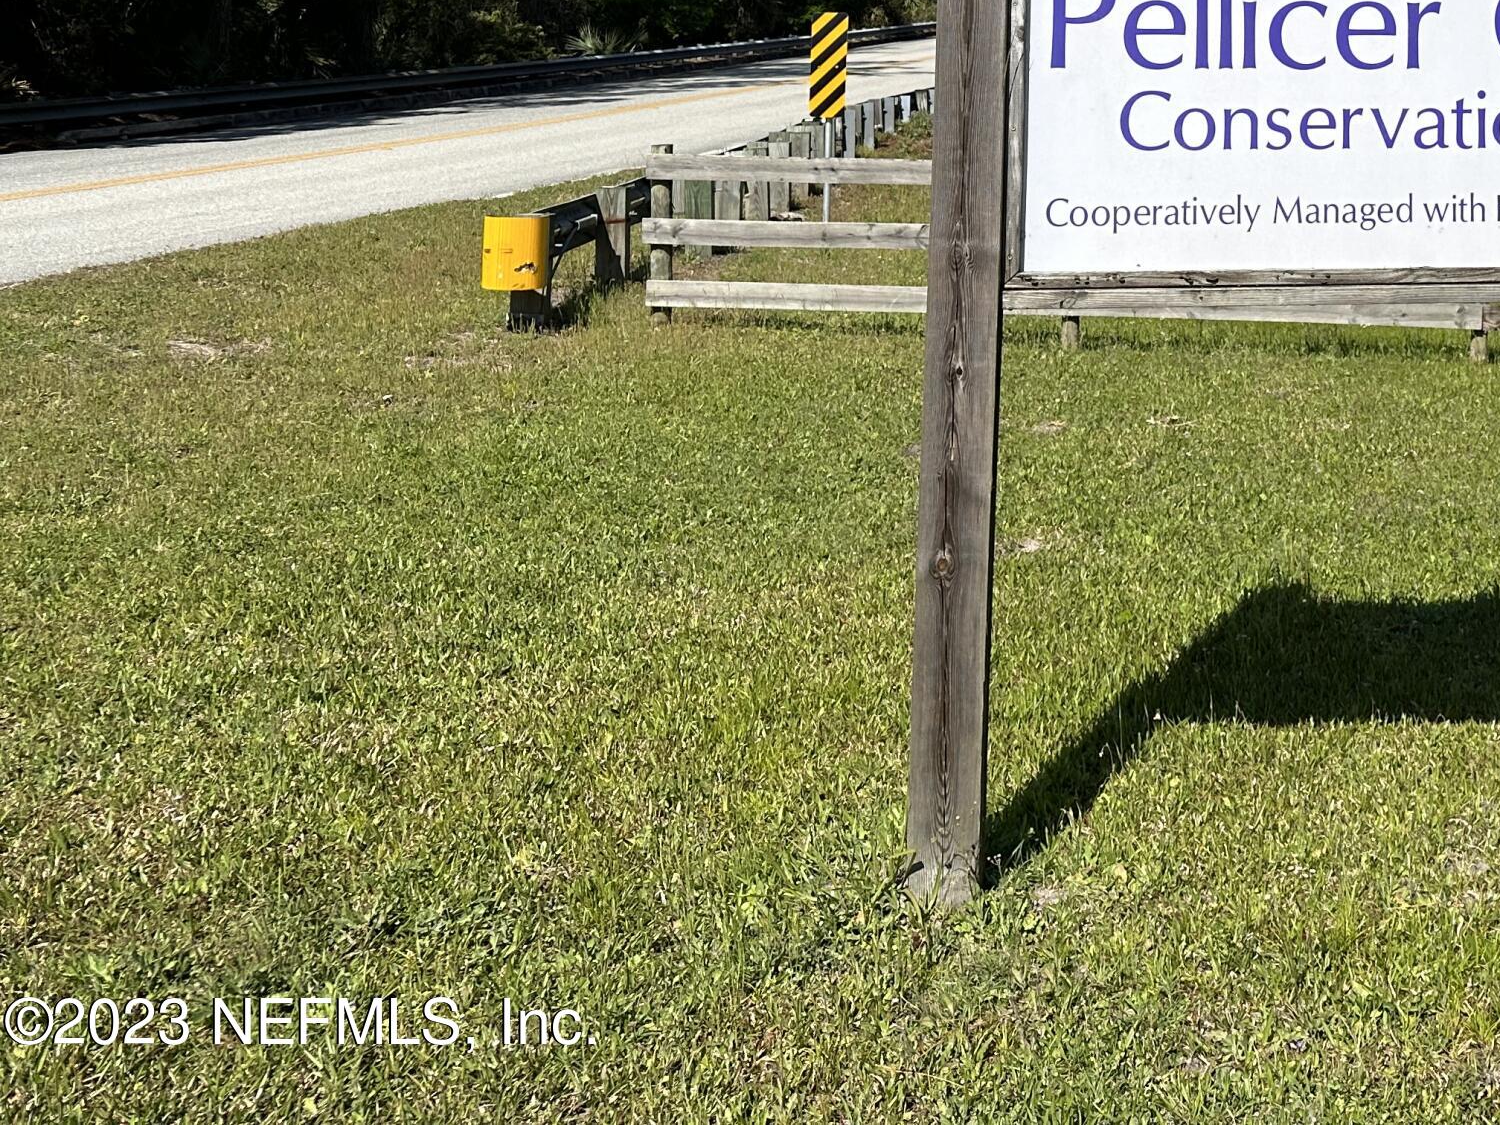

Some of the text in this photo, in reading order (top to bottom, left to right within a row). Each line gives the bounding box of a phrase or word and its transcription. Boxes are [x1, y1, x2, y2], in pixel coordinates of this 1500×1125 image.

[1045, 194, 1261, 234] Cooperatively
[1273, 192, 1413, 231] Managed
[1423, 192, 1486, 223] with
